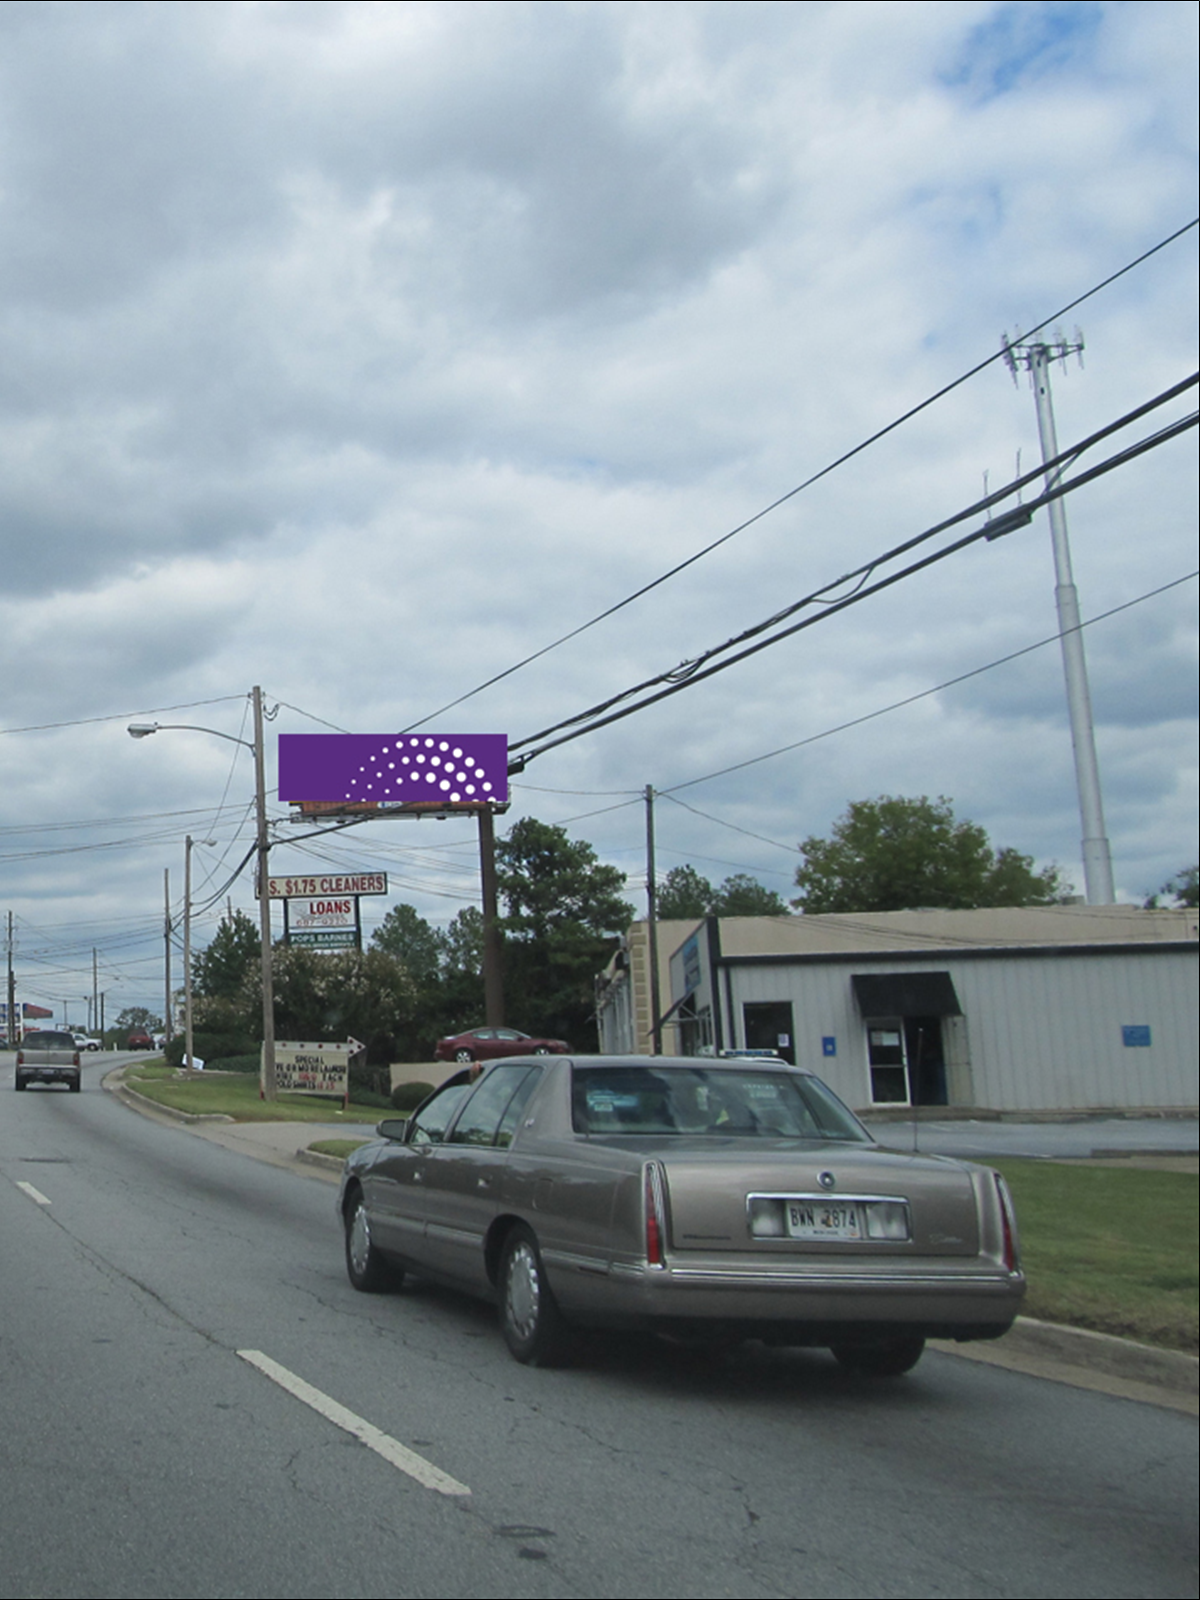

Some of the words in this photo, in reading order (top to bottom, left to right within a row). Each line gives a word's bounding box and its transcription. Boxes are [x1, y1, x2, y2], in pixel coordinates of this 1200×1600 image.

[285, 878, 317, 896] $1.75
[320, 875, 384, 893] CLEANERS
[310, 900, 351, 915] LOANS
[790, 1207, 815, 1227] BWN
